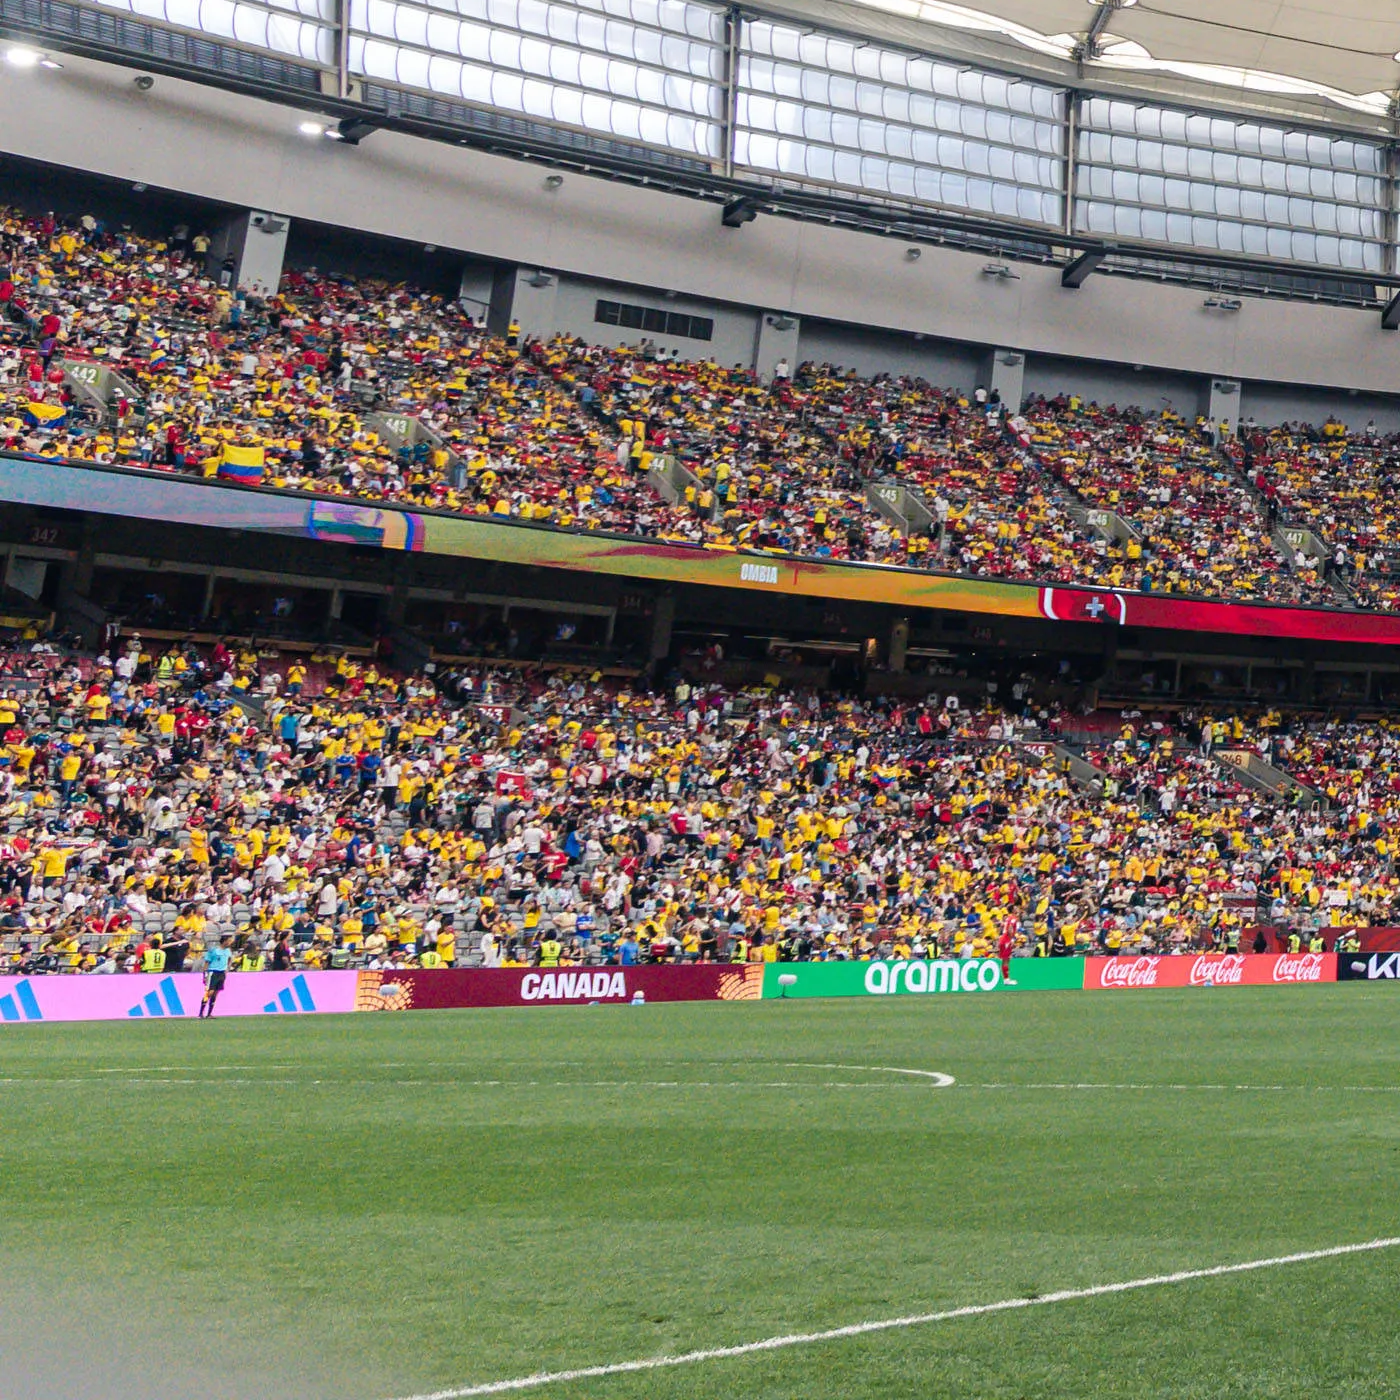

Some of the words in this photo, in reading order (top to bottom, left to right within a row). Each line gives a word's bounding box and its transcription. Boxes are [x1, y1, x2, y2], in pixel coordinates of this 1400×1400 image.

[71, 366, 97, 384] 442
[1286, 532, 1304, 544] 447
[740, 563, 778, 584] OMBIA
[864, 958, 1001, 994] aramco
[1100, 957, 1159, 986] Coca-Cola
[1189, 954, 1246, 984] Coca-Cola
[1272, 953, 1324, 981] Coca-Cola
[520, 972, 627, 1000] CANADA
